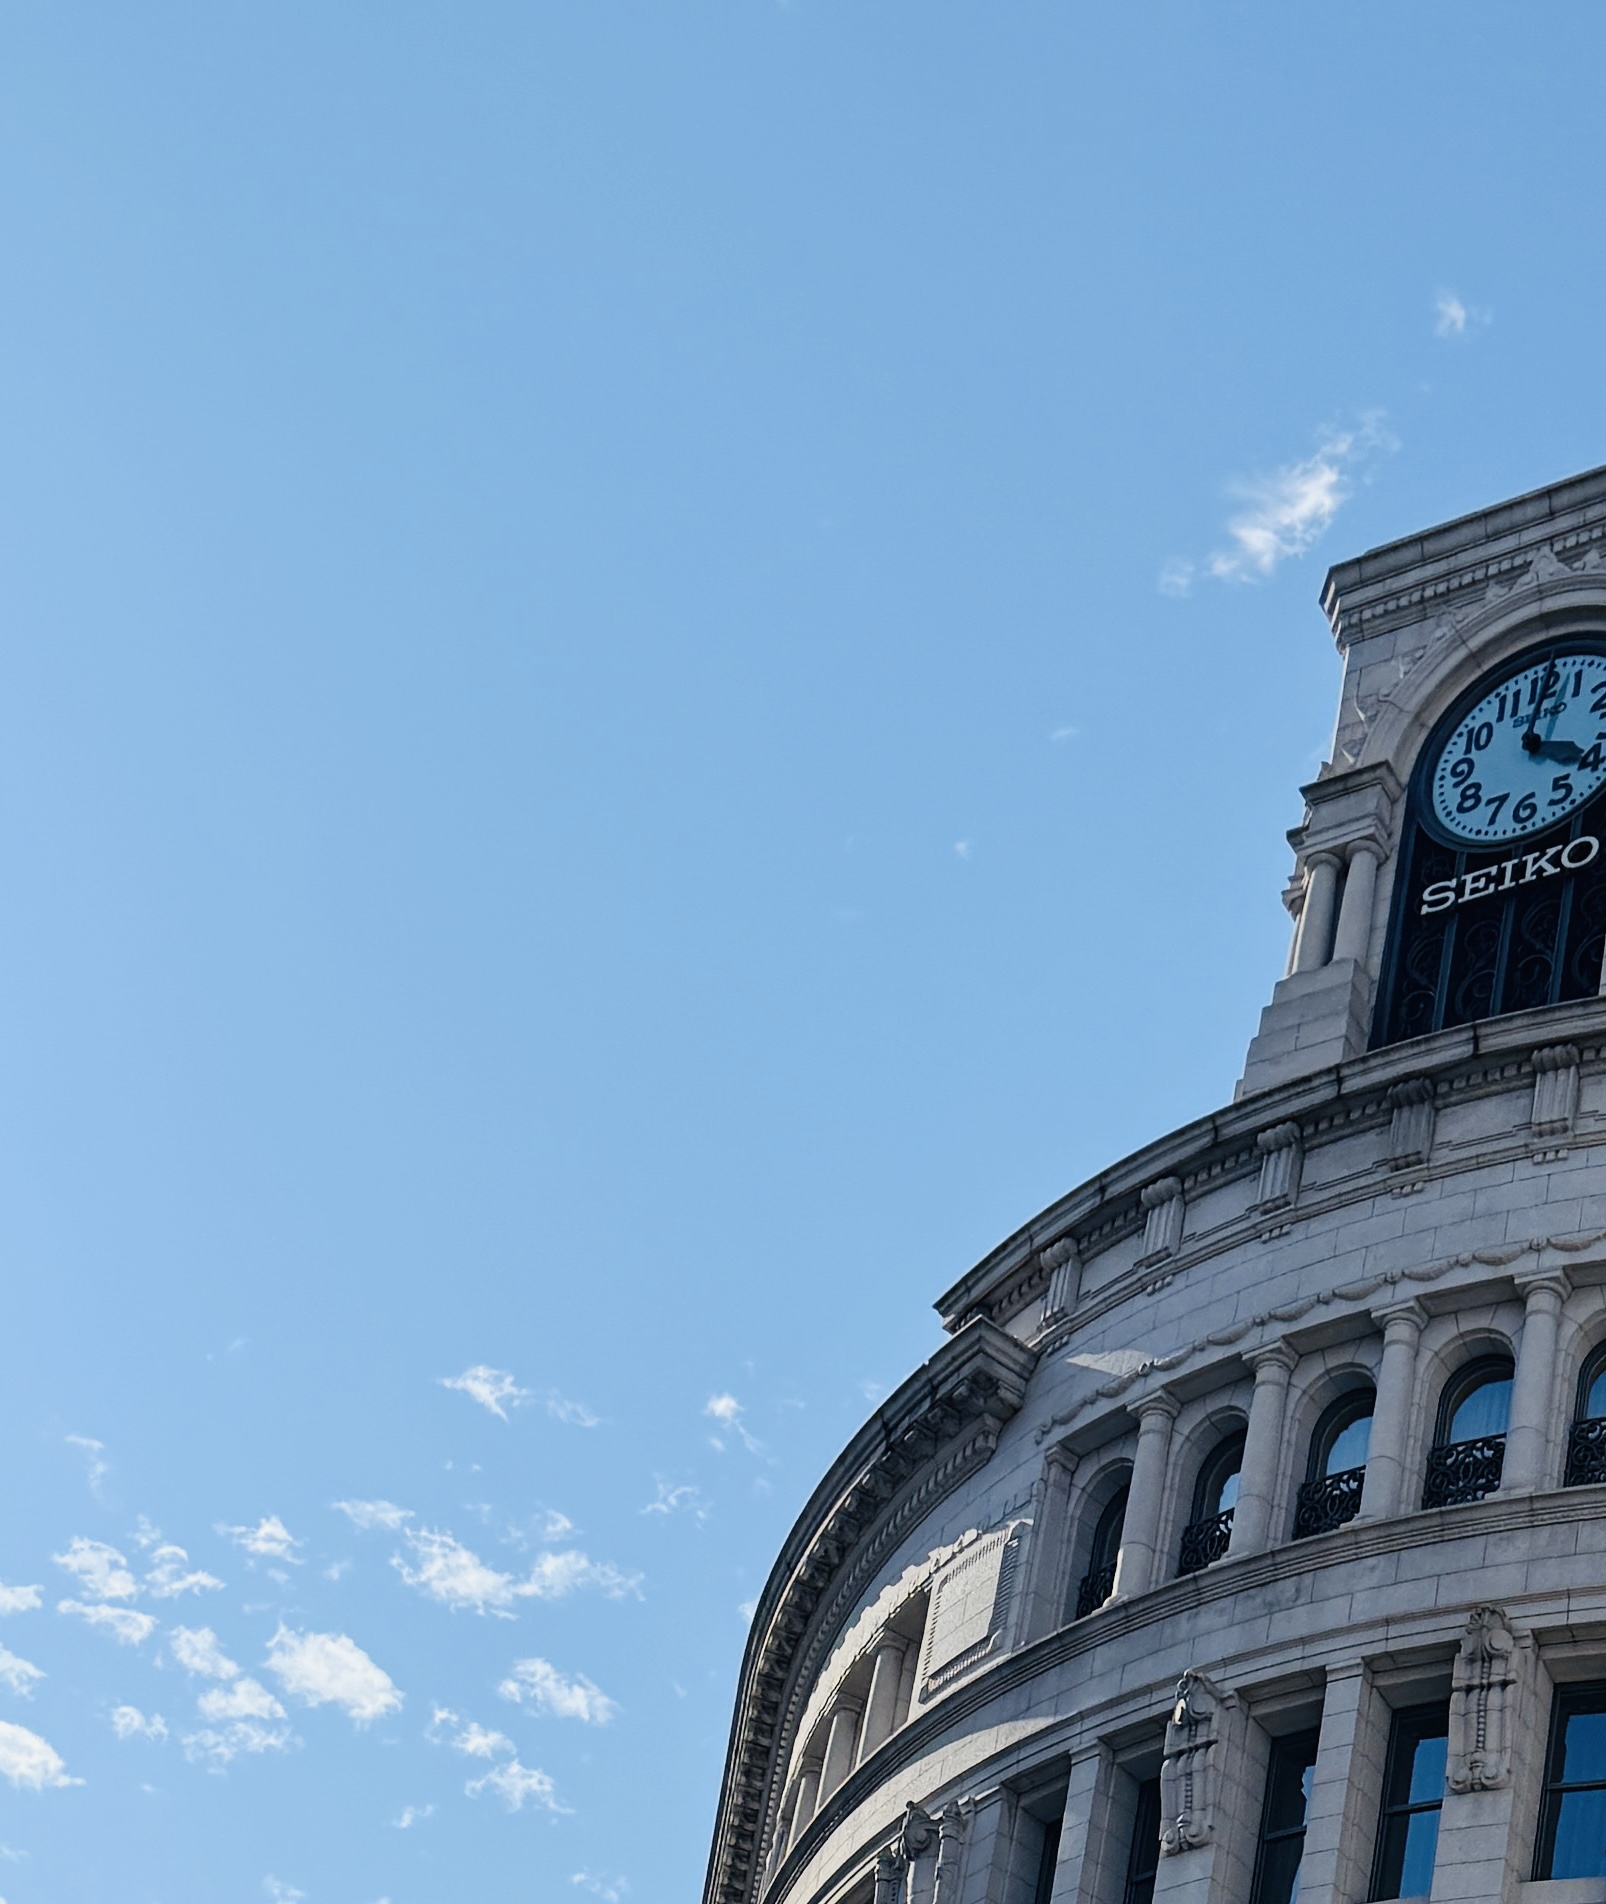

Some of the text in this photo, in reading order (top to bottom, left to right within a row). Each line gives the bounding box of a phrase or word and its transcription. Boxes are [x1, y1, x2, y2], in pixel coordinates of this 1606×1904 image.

[1528, 671, 1560, 706] 12
[1571, 669, 1583, 698] 1
[1496, 688, 1521, 723] 11
[1463, 721, 1494, 756] 10
[1450, 757, 1475, 788] 9
[1577, 742, 1606, 773] 4
[1456, 782, 1482, 814] 8
[1547, 773, 1573, 807] 5
[1485, 792, 1511, 827] 7
[1512, 792, 1537, 824] 6
[1420, 836, 1600, 915] SEIKO
